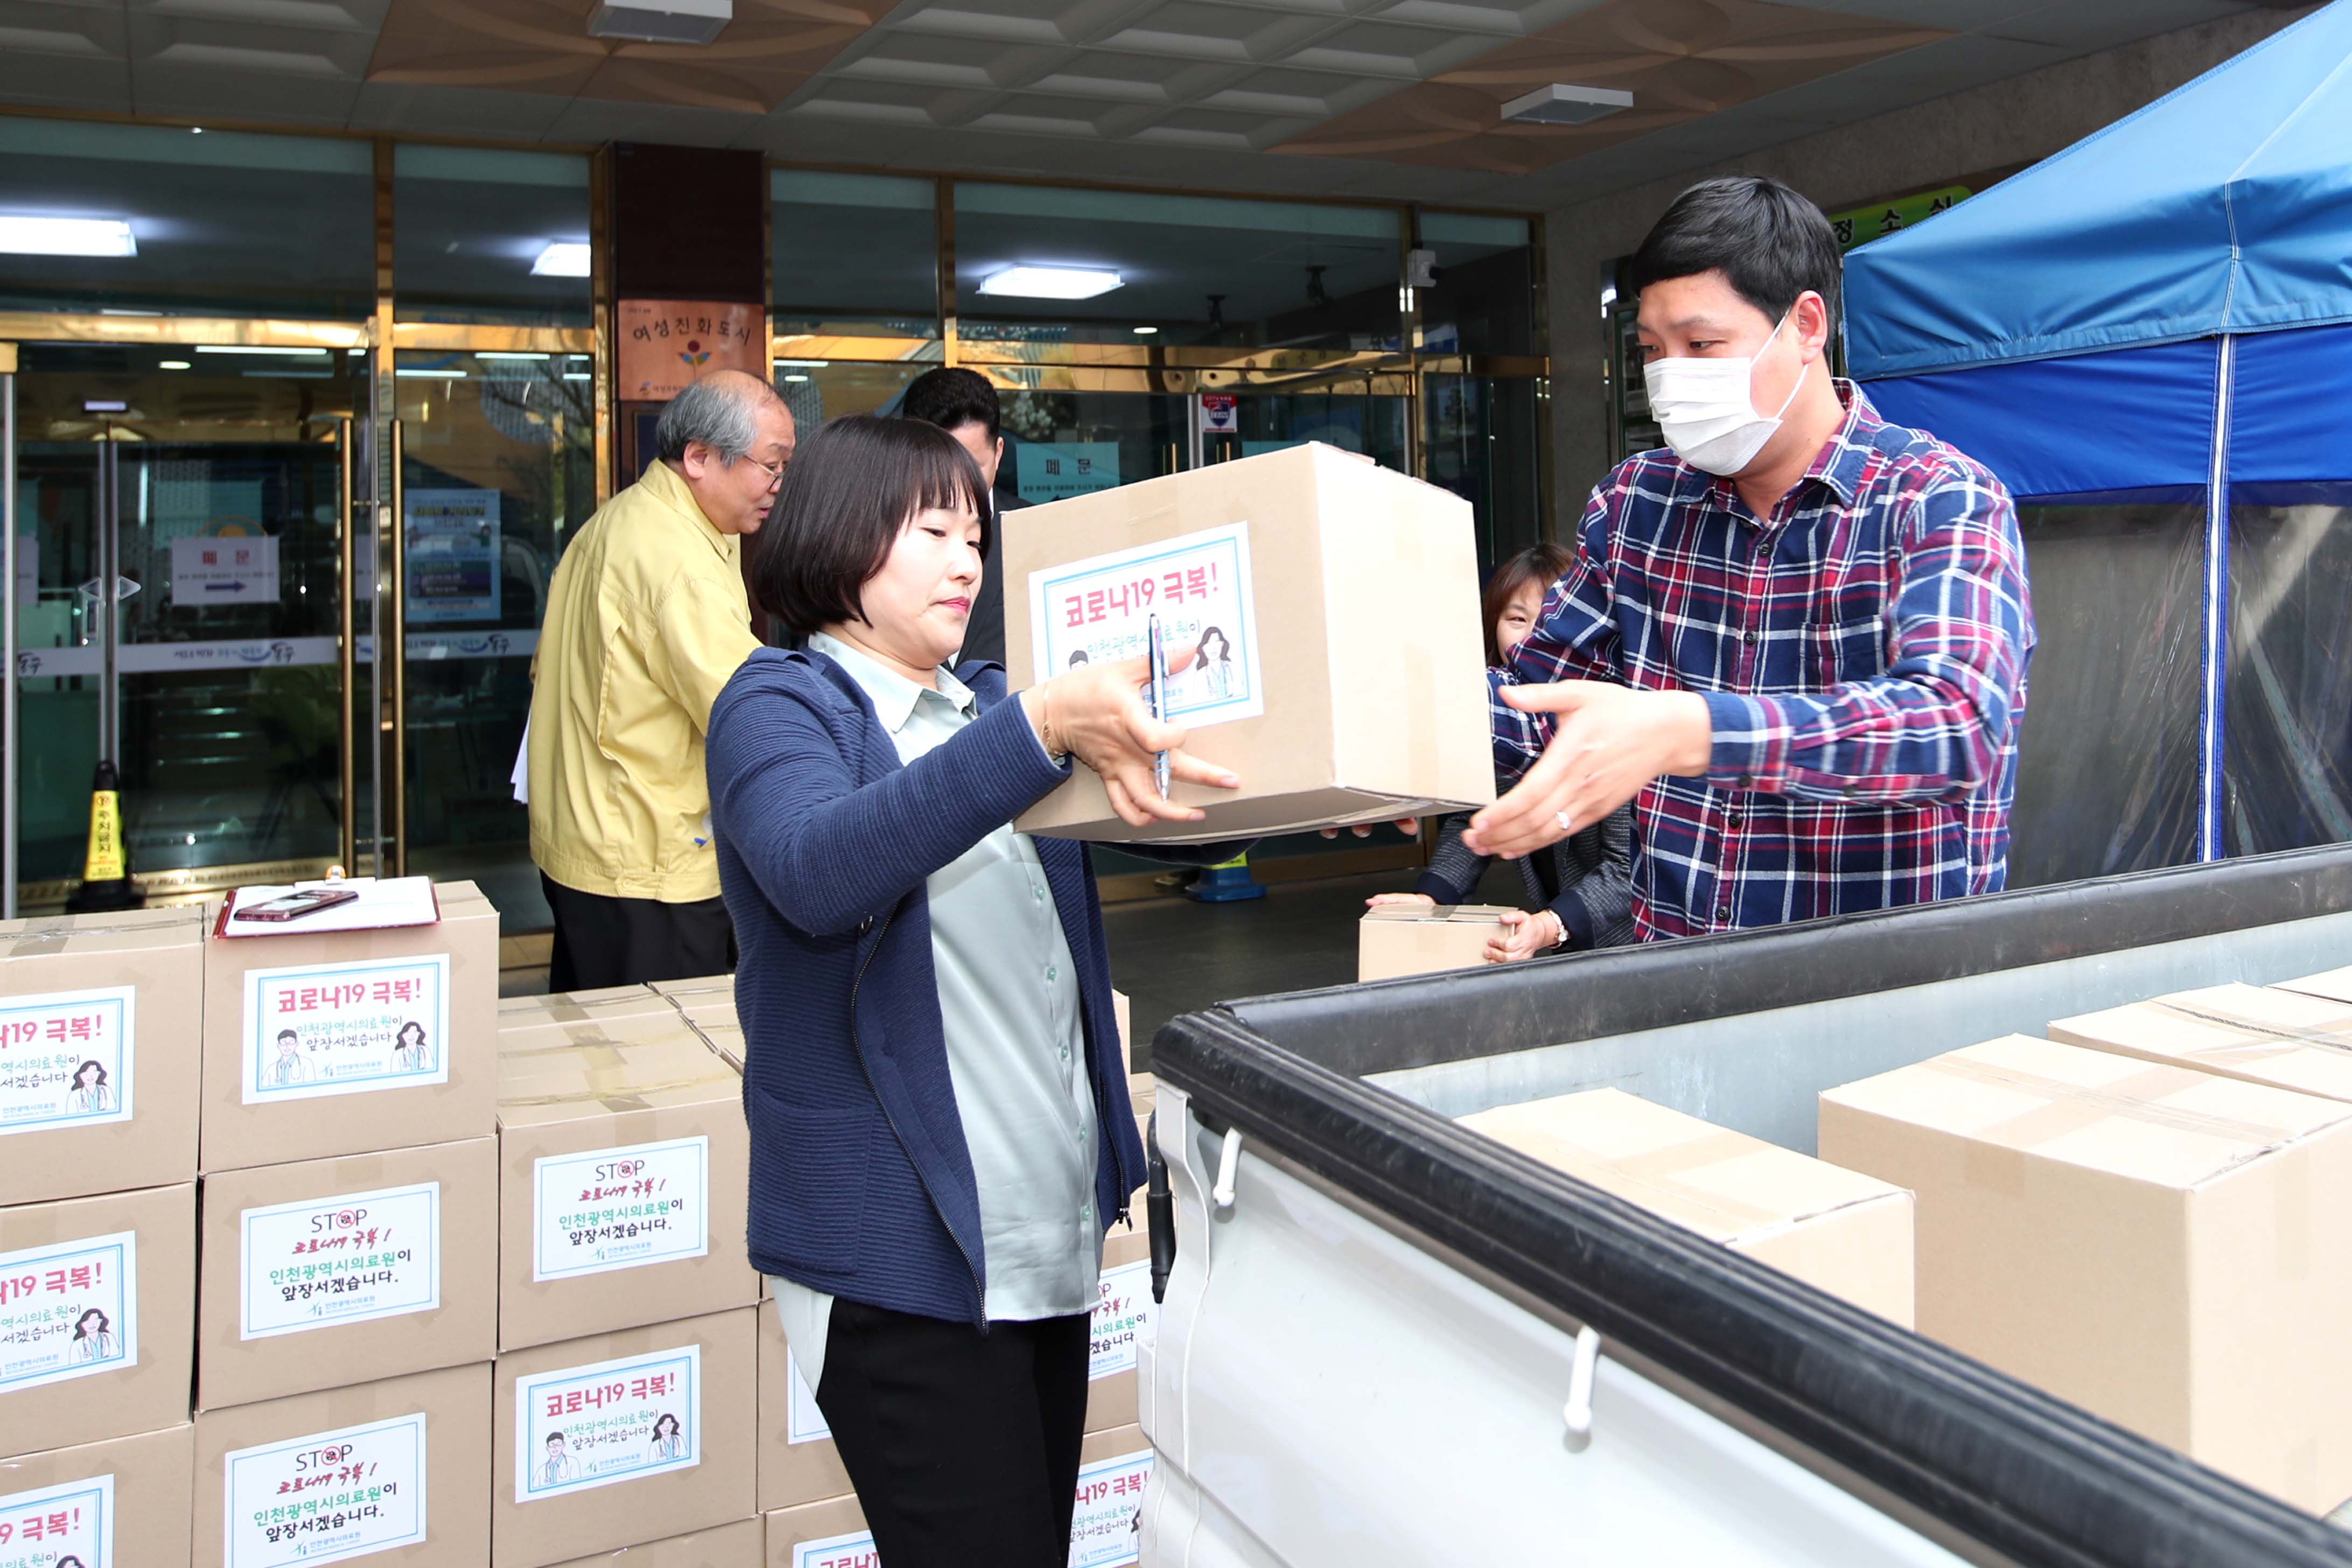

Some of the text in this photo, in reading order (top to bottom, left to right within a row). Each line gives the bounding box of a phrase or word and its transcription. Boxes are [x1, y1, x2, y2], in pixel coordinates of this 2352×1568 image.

[1065, 562, 1218, 628] 코로나19 극복!
[278, 978, 421, 1013] 코로나19 극복!
[46, 1014, 101, 1042] 극복!
[559, 1198, 683, 1231] 인천광역시의료원이
[569, 1218, 672, 1246] 앞장서겠습니다.
[45, 1262, 101, 1294] 극복!
[269, 1249, 411, 1286] 인천광역시의료원이
[282, 1270, 399, 1302] 앞장서겠습니다.
[547, 1372, 674, 1417] 코로나19 극복!
[254, 1482, 397, 1528] 인천광역시의료원이
[23, 1507, 80, 1541] 극복!
[266, 1504, 385, 1543] 앞장서겠습니다.
